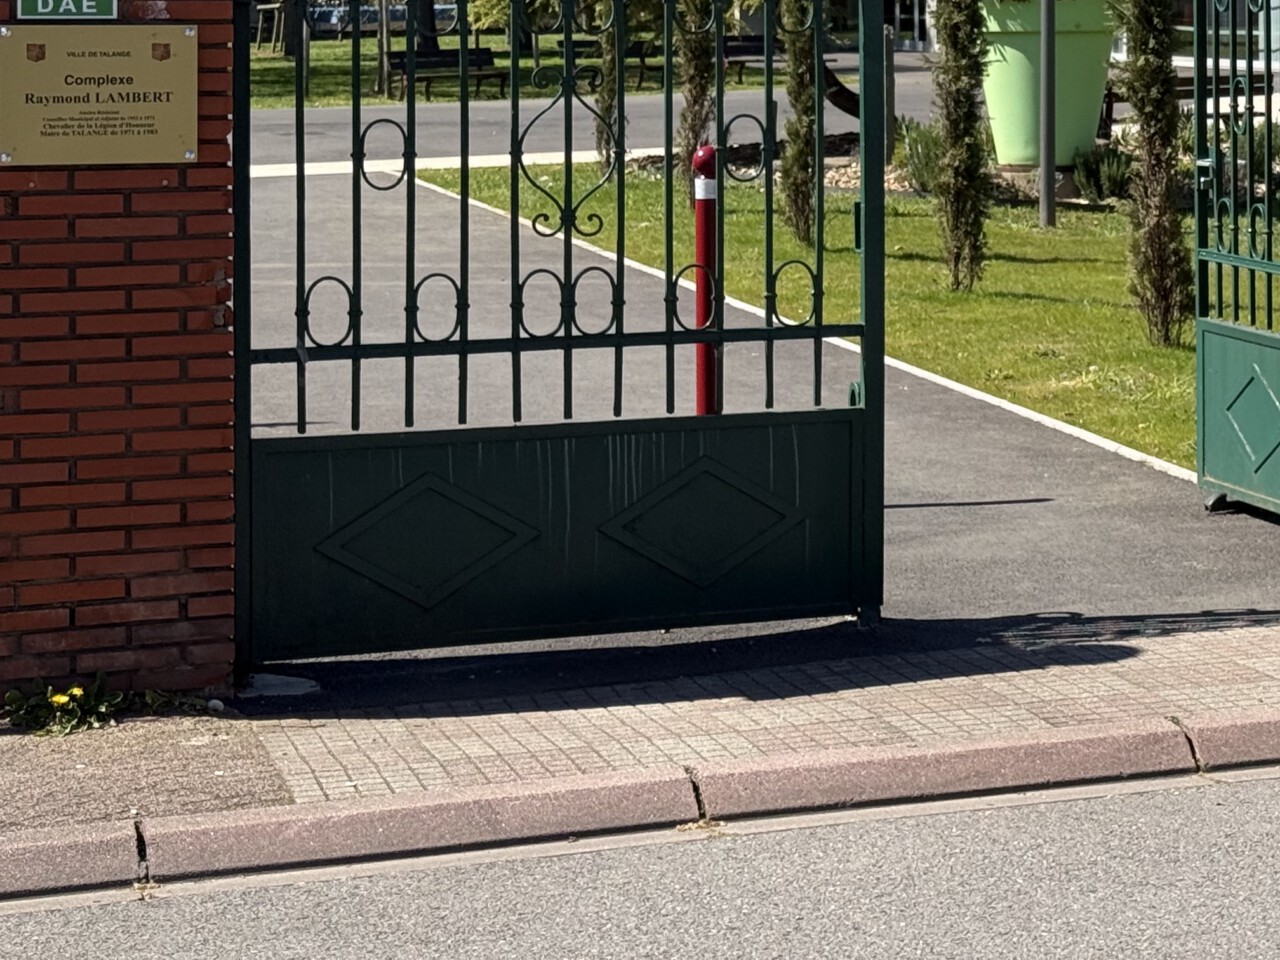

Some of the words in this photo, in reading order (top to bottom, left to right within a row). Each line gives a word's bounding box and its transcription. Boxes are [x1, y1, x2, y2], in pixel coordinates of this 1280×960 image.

[64, 74, 134, 88] Complexe
[25, 93, 90, 107] Raymond
[95, 92, 173, 104] LAMBERT
